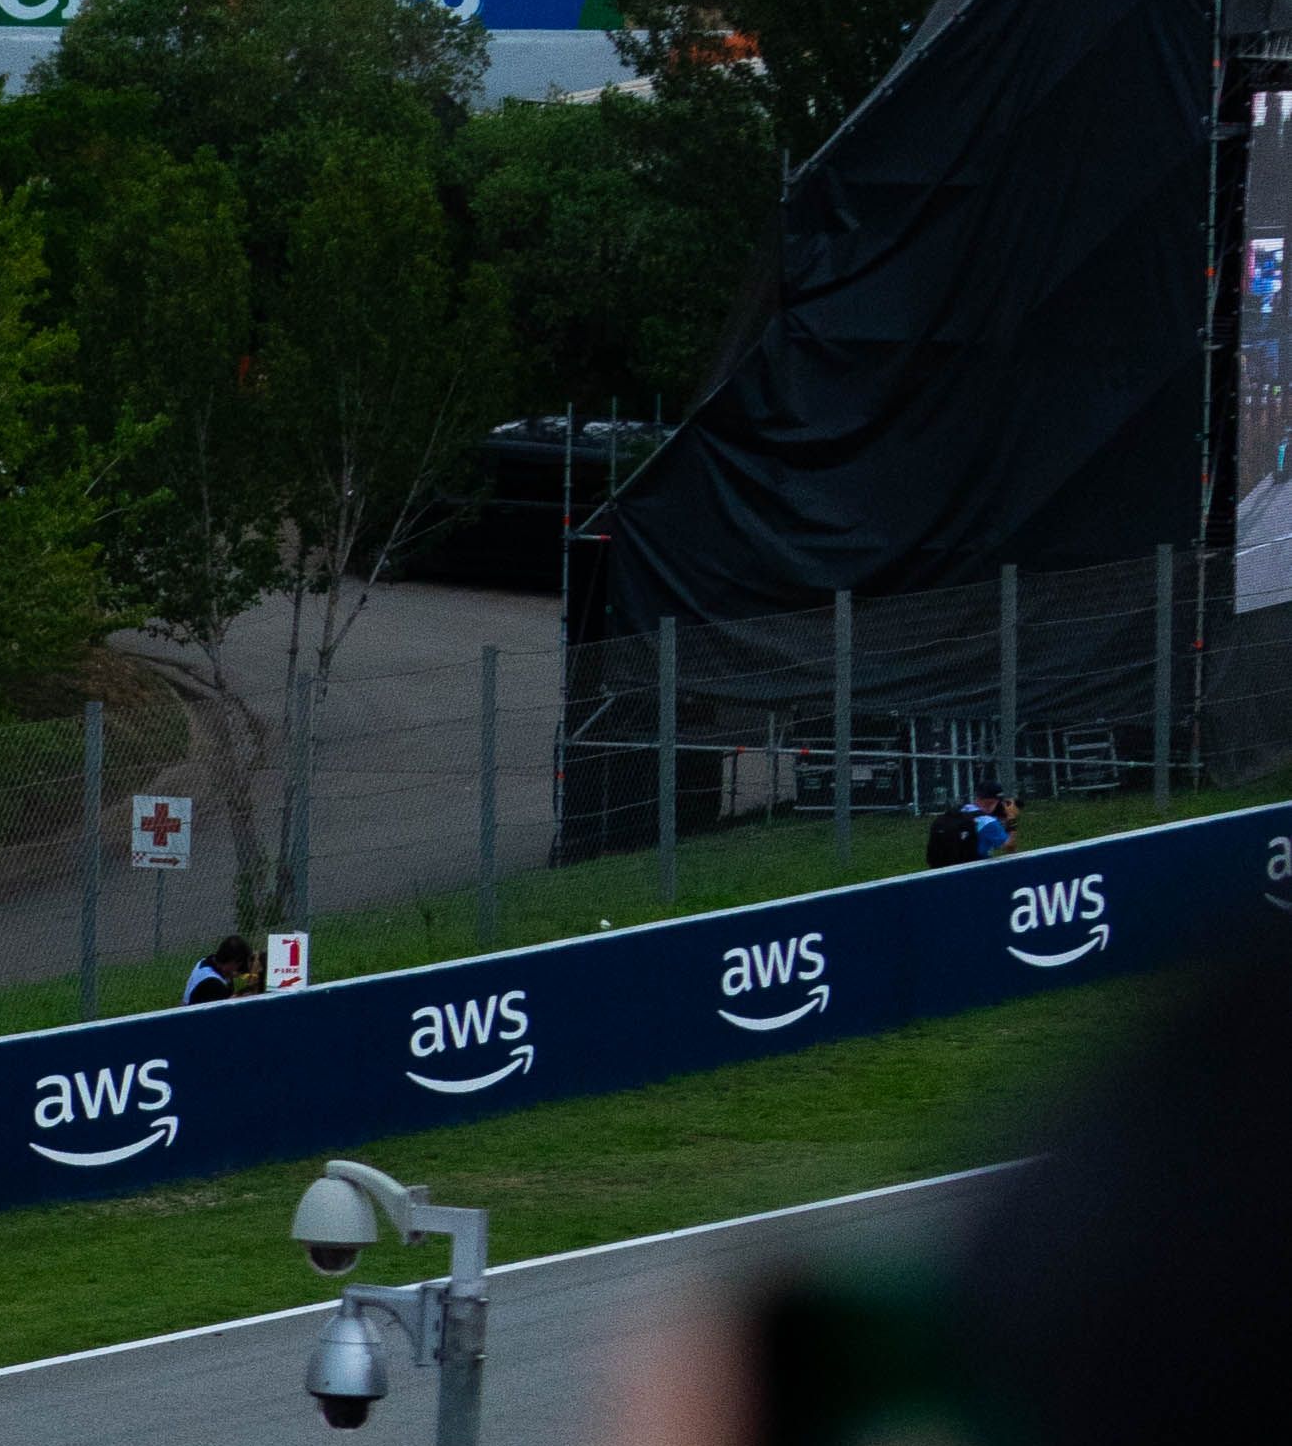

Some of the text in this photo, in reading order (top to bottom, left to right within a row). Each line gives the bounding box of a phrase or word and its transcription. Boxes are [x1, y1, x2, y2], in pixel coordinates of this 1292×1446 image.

[1009, 872, 1106, 934] aws
[721, 932, 826, 997] aws
[409, 989, 529, 1058] aws
[33, 1057, 173, 1131] aws
